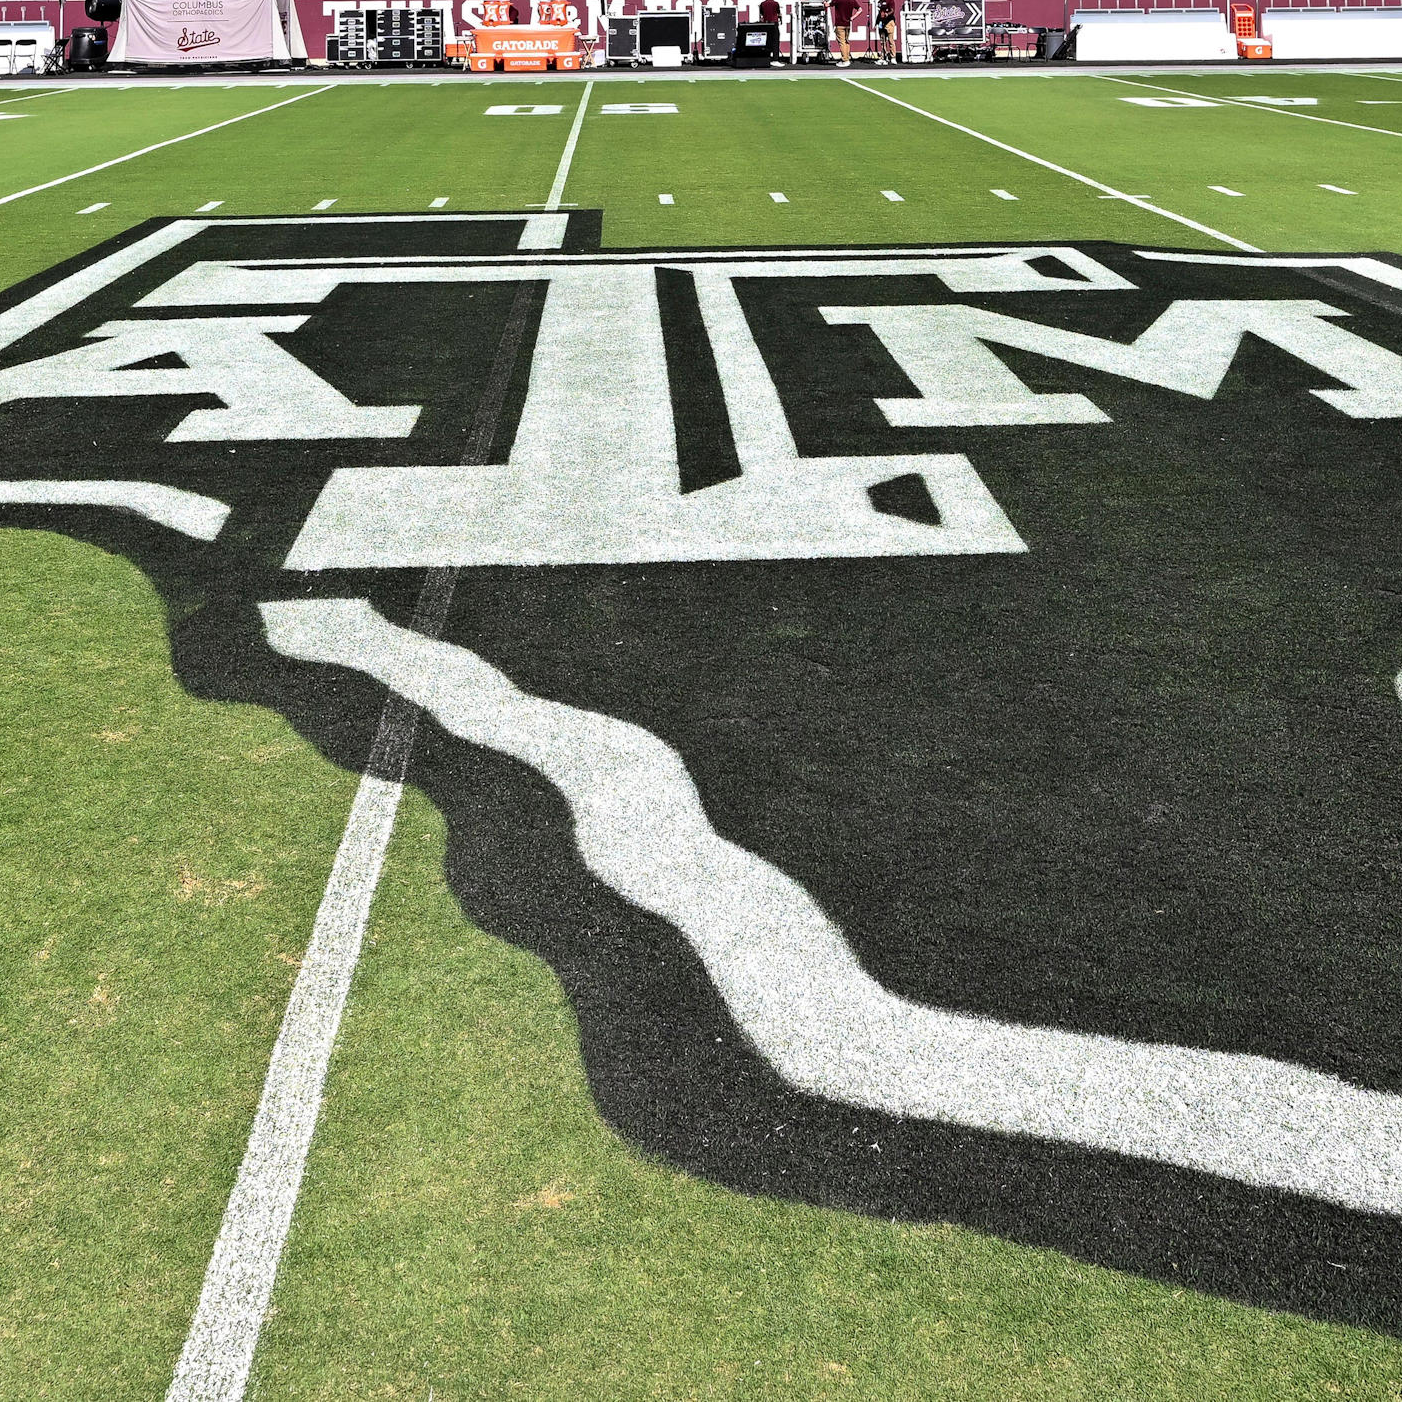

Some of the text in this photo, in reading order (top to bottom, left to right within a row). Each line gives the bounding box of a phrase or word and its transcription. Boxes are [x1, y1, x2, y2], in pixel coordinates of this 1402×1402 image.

[173, 1, 223, 10] COLUMBUS
[173, 9, 224, 17] ORTHOPAEDICS
[177, 27, 220, 48] State
[492, 39, 559, 51] GATORADE
[1255, 46, 1263, 55] G
[477, 59, 487, 69] G
[563, 57, 573, 67] G
